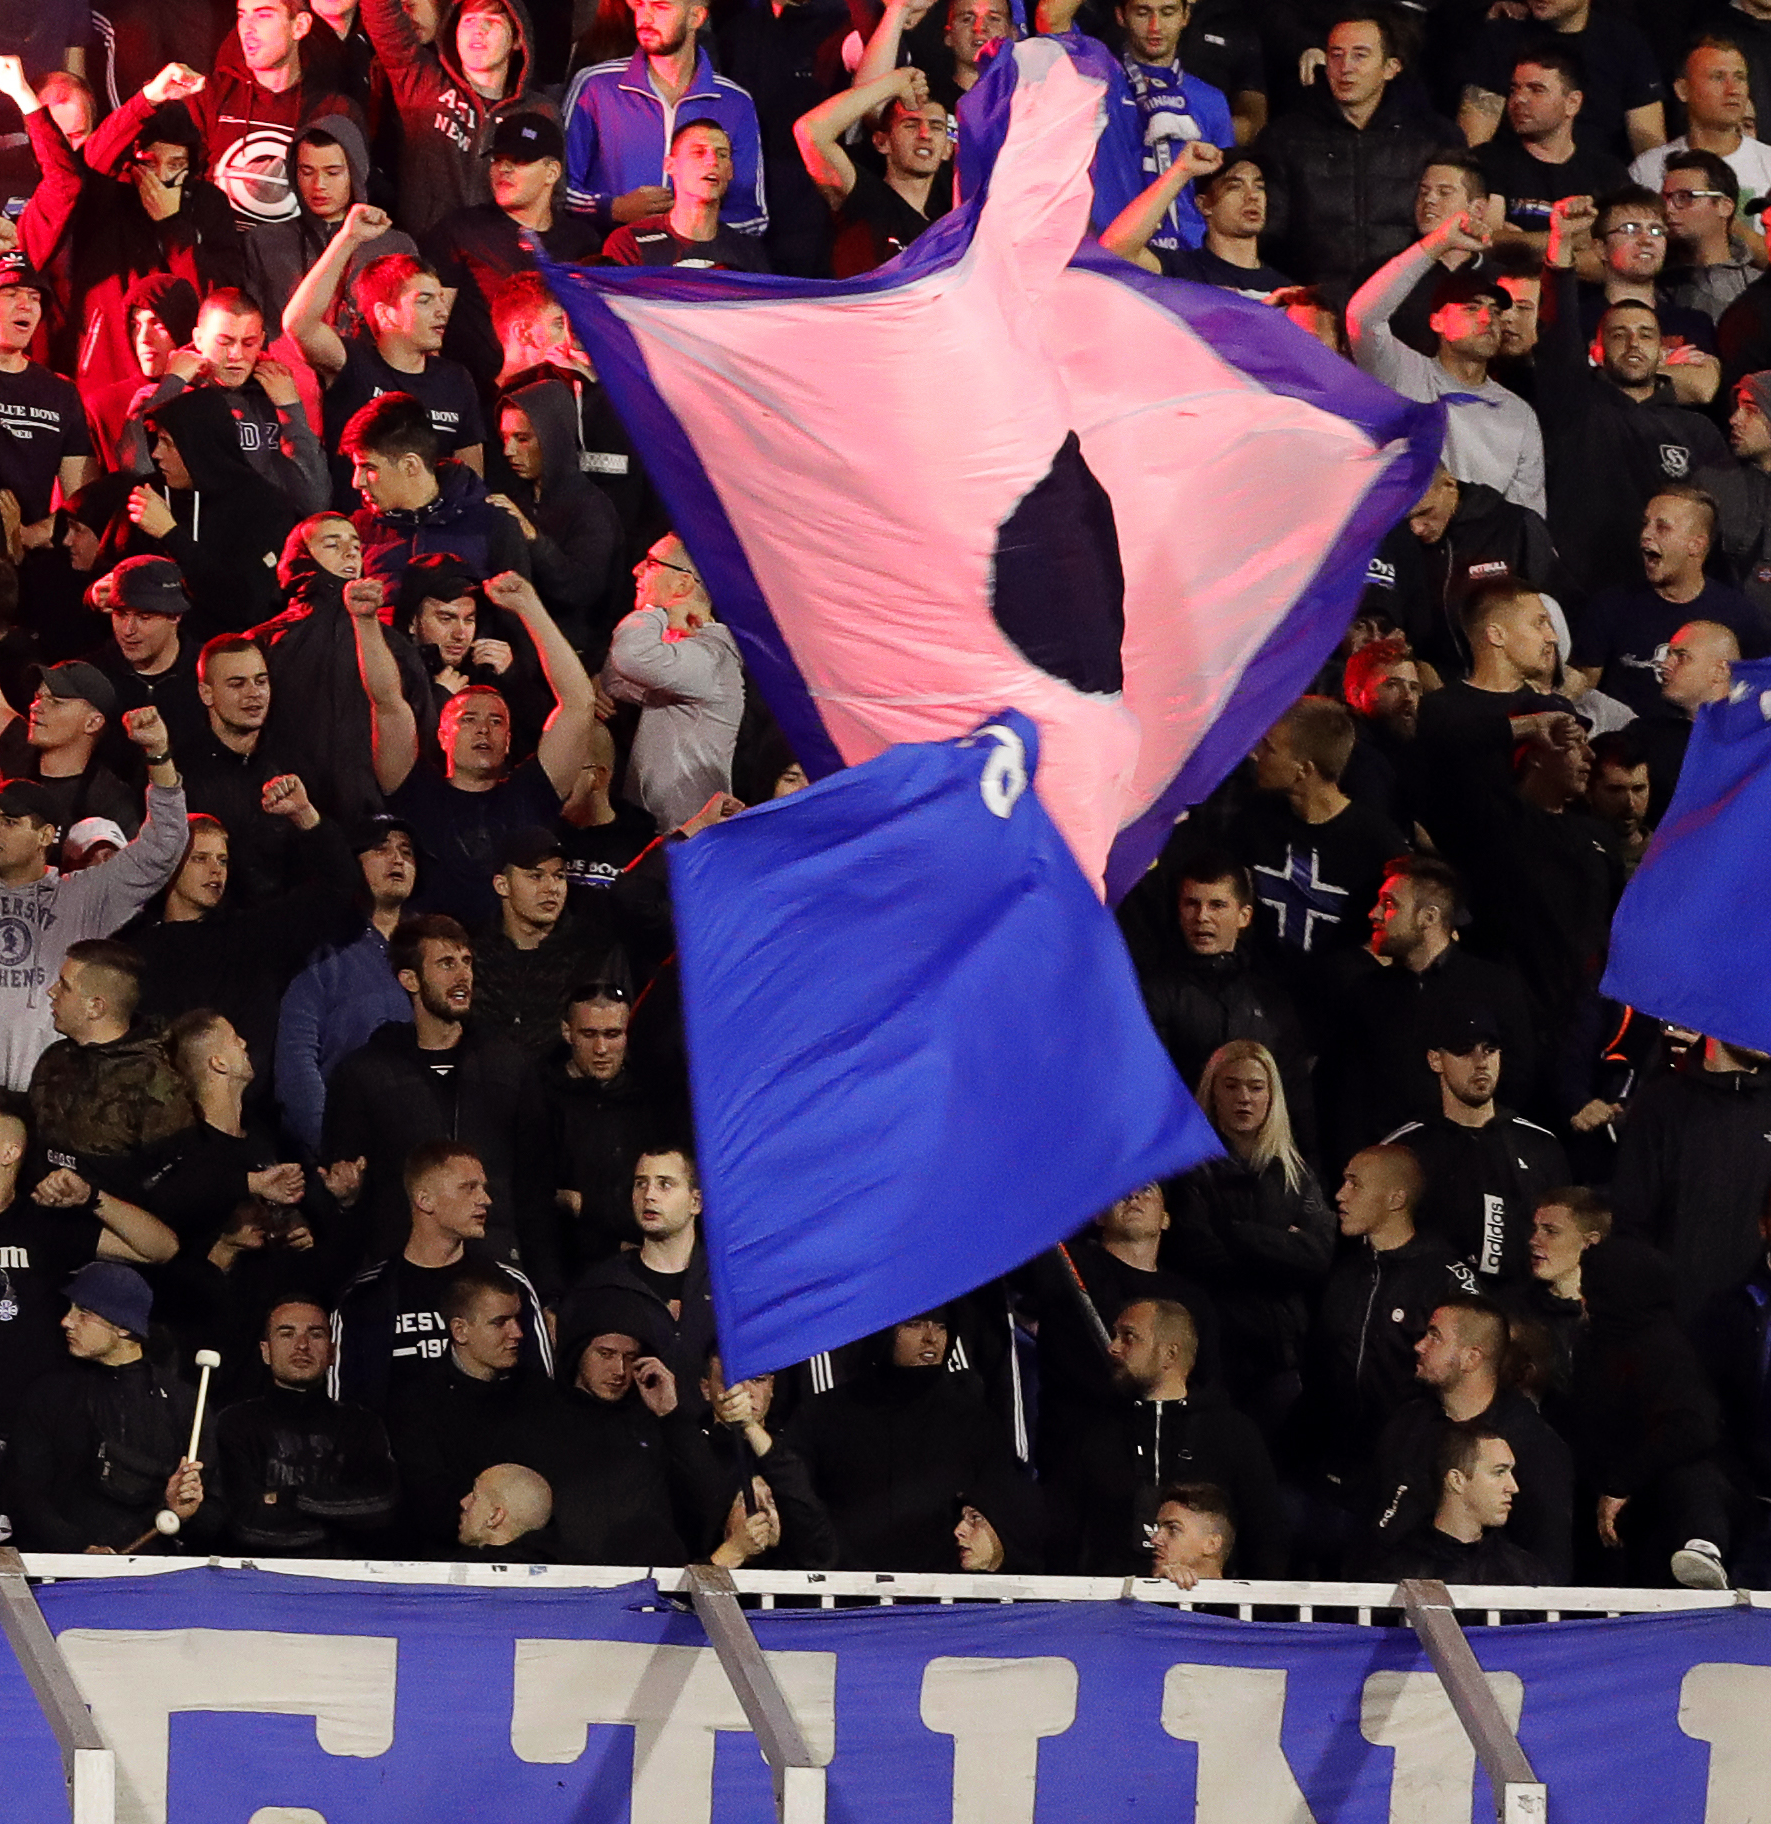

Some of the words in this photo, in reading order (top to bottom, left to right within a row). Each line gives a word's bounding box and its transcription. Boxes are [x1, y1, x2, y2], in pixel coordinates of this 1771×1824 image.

[434, 113, 472, 153] NEW
[29, 406, 61, 423] BOYS
[430, 410, 459, 424] BOYS
[1368, 558, 1396, 578] OYS
[588, 860, 620, 876] BOY
[1486, 1201, 1504, 1270] adidas
